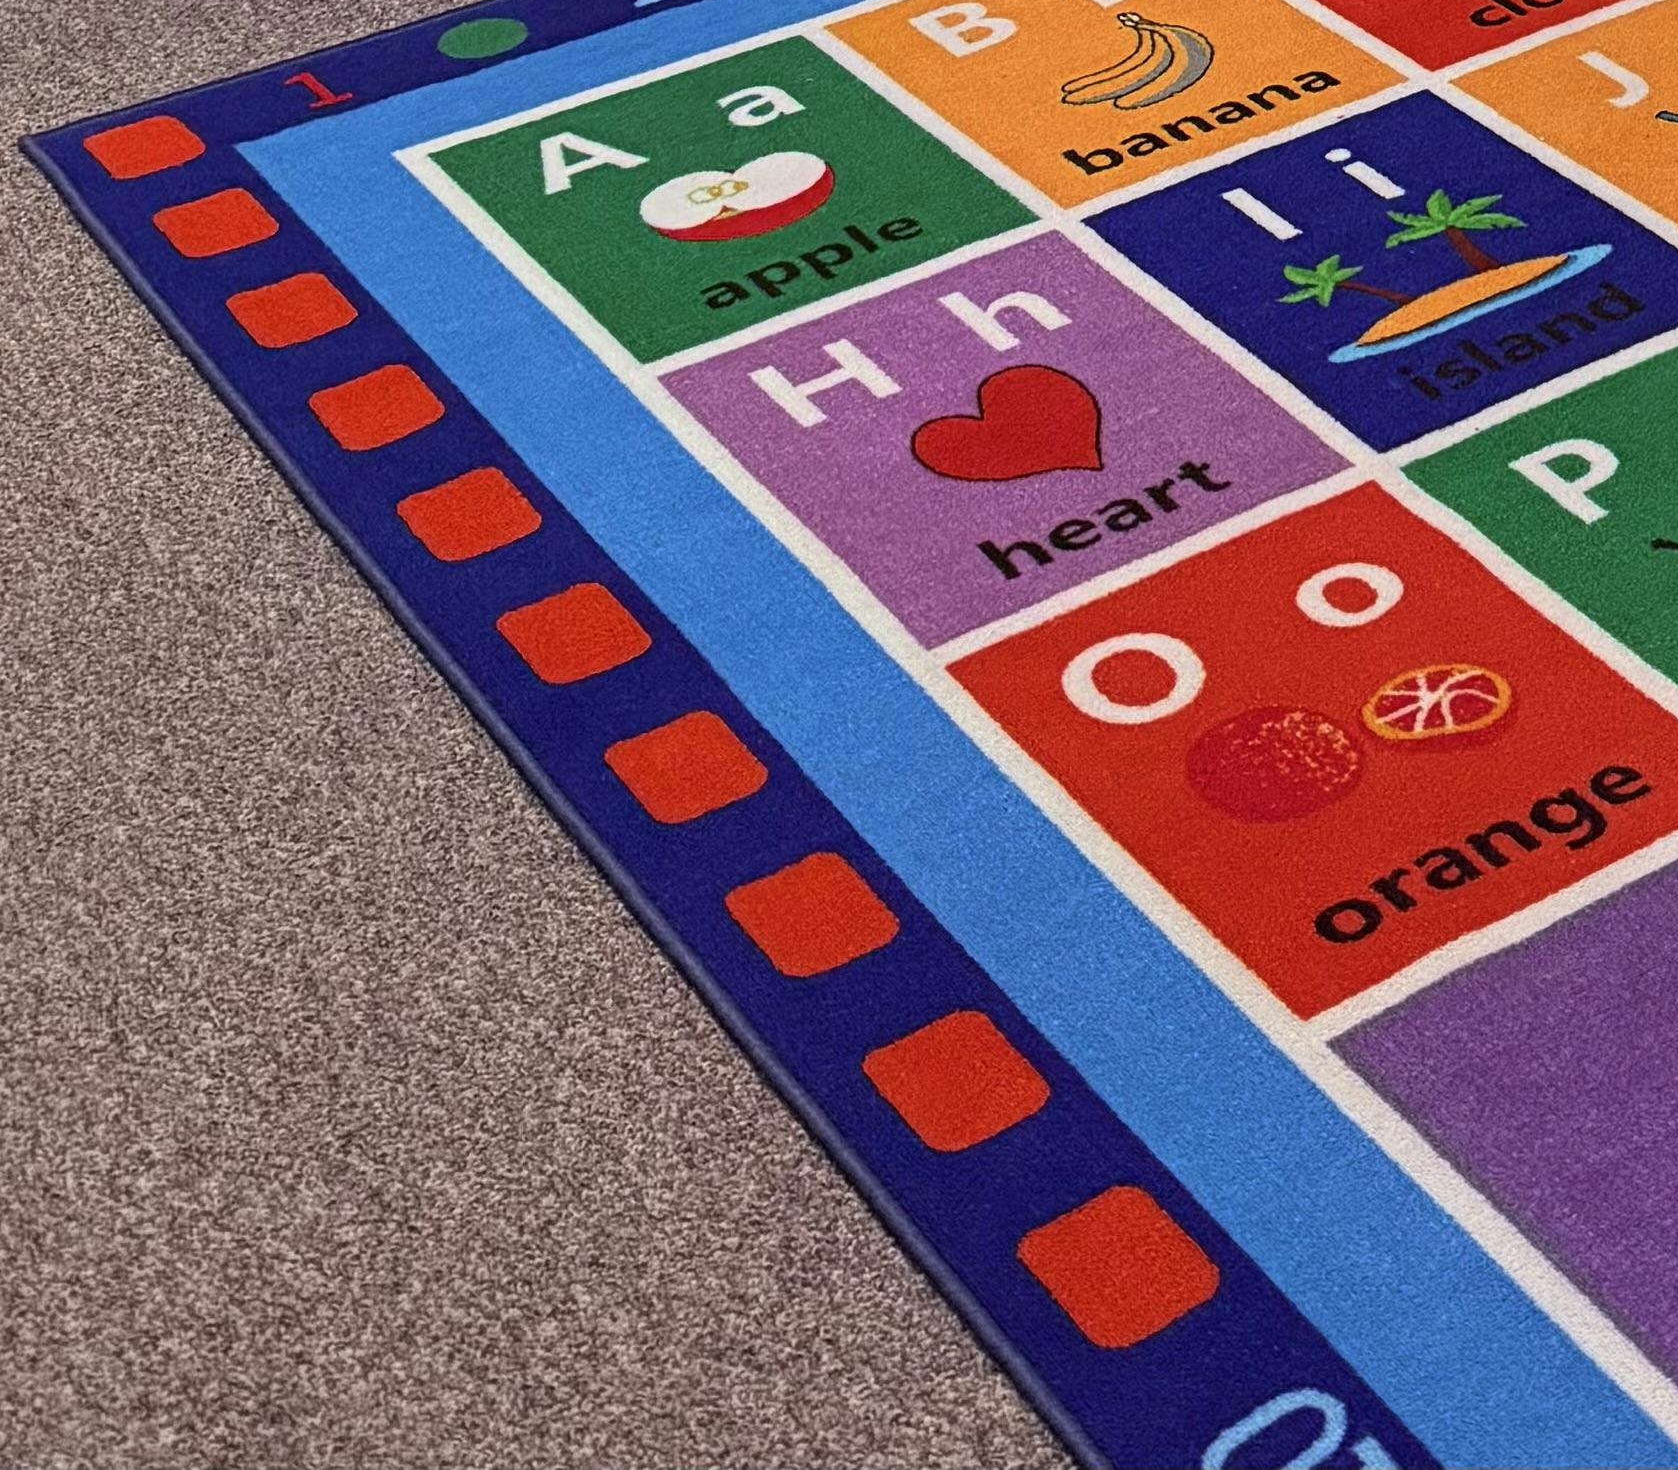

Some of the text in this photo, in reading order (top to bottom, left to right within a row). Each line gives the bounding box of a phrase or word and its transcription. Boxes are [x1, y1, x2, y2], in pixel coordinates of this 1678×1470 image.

[283, 71, 353, 109] 1
[534, 83, 806, 198] A a
[1060, 62, 1342, 180] banana
[698, 206, 926, 314] apple
[745, 282, 1074, 431] H h
[1394, 277, 1649, 405] island
[974, 455, 1233, 584] heart
[1507, 438, 1621, 526] P
[1060, 561, 1405, 725] O o
[1311, 755, 1656, 949] orange
